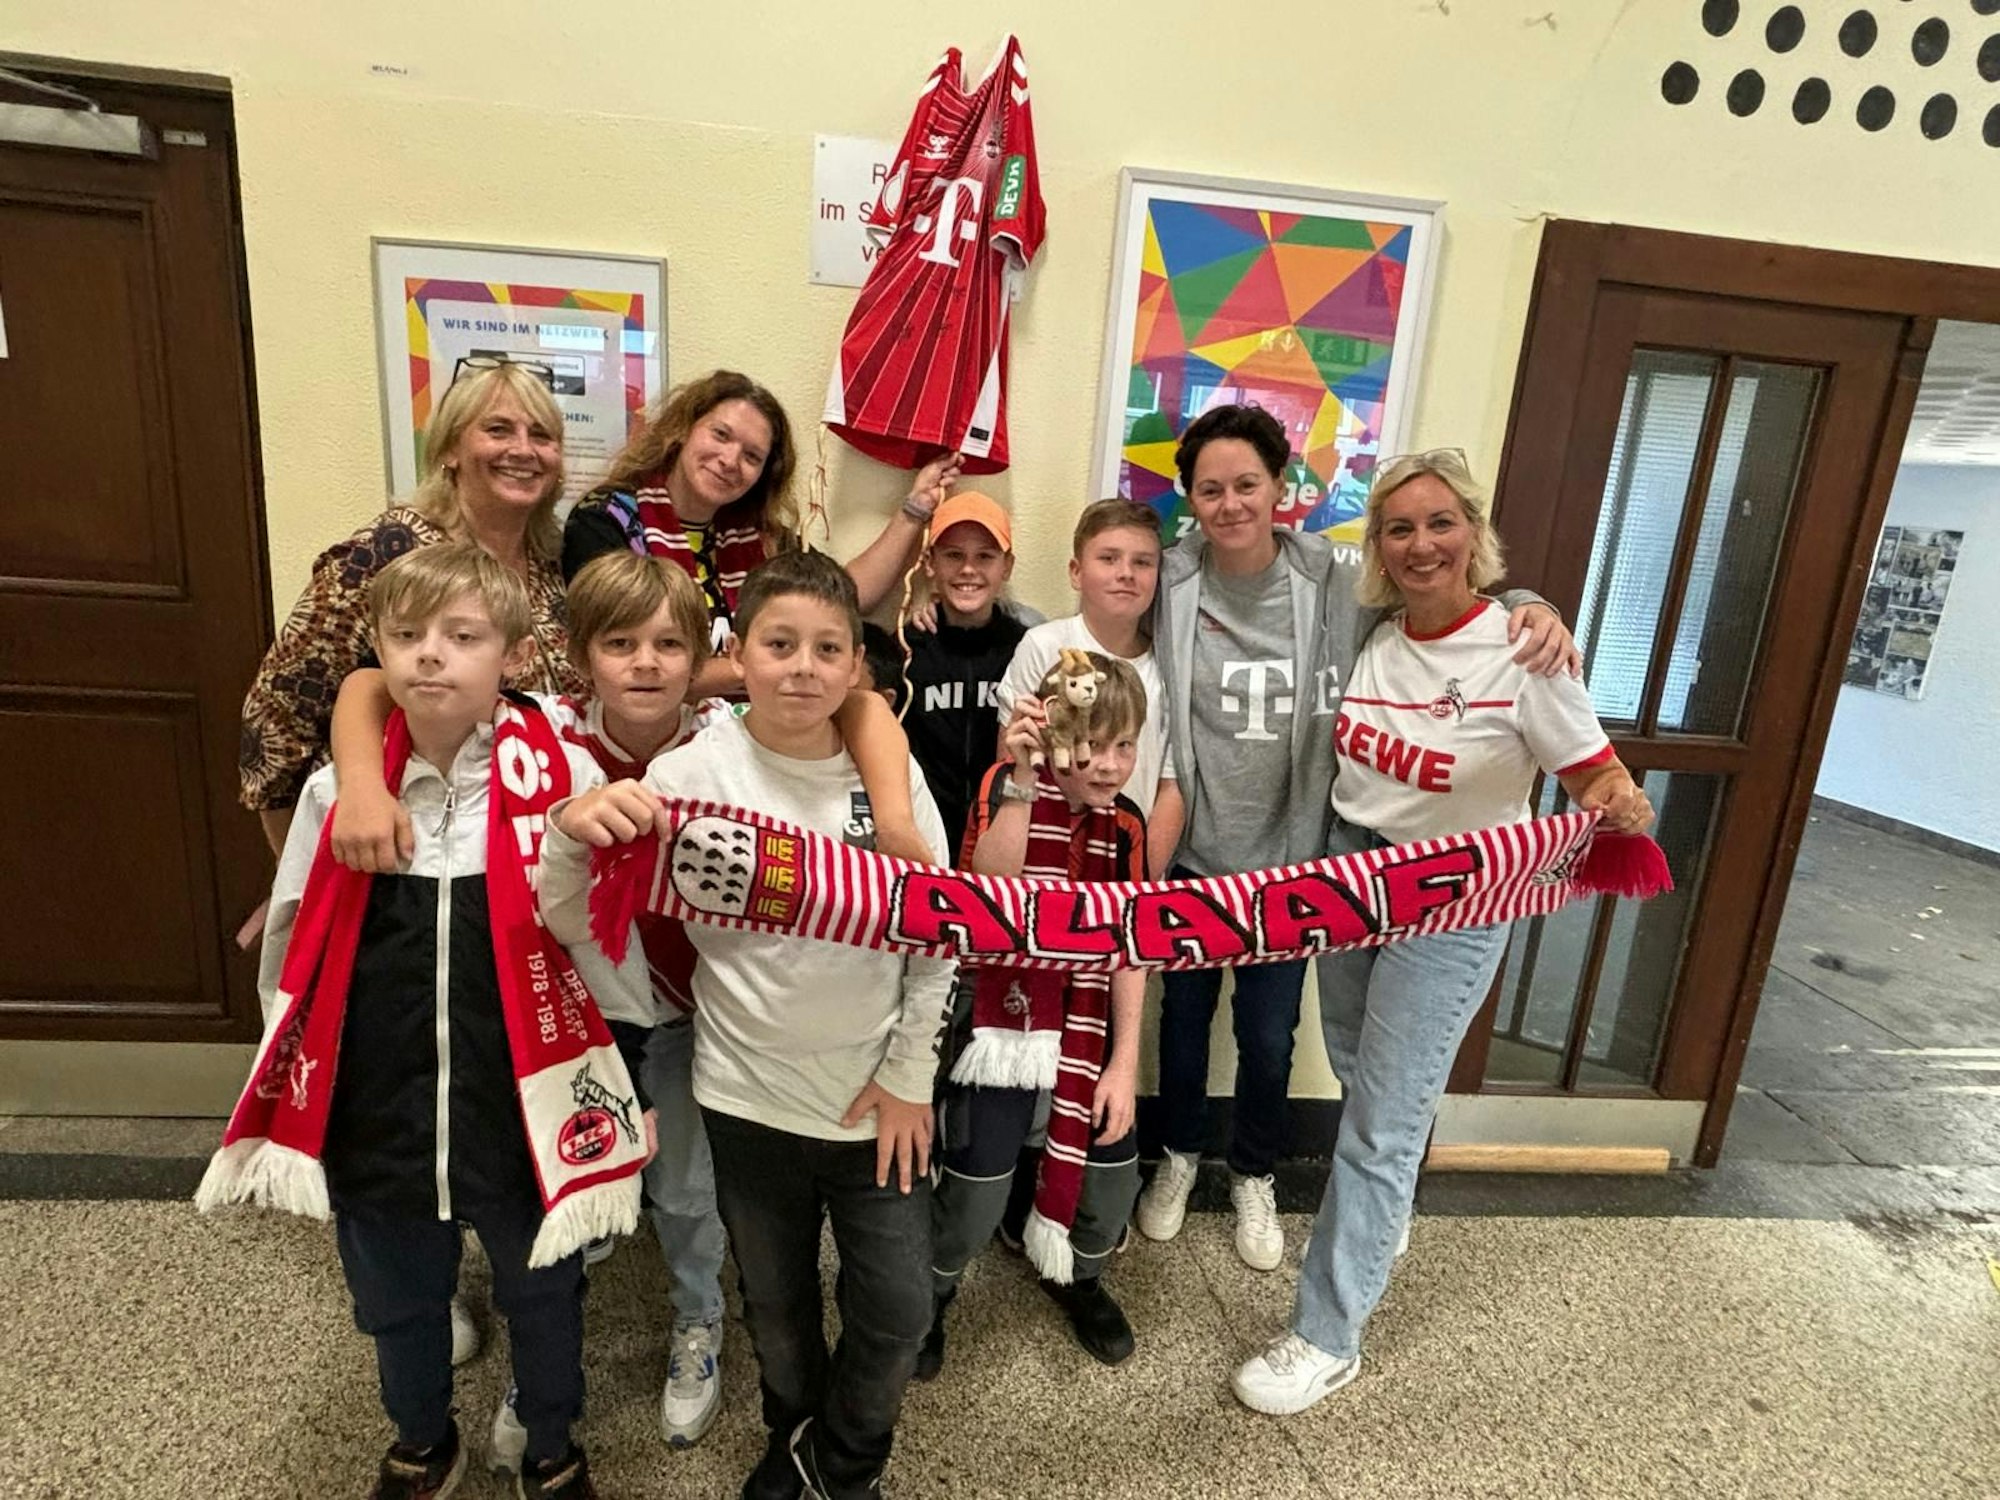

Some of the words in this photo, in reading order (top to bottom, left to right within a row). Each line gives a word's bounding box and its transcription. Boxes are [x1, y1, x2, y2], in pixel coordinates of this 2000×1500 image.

[820, 199, 844, 220] im
[913, 176, 983, 267] T
[443, 318, 470, 330] WIR
[476, 321, 508, 333] SIND
[514, 325, 530, 335] IM
[560, 412, 594, 423] HEN:
[1221, 659, 1294, 740] T
[1334, 711, 1456, 793] REWE
[886, 844, 1483, 969] ALAAF
[527, 951, 549, 993] 1978
[537, 1004, 559, 1044] 1983
